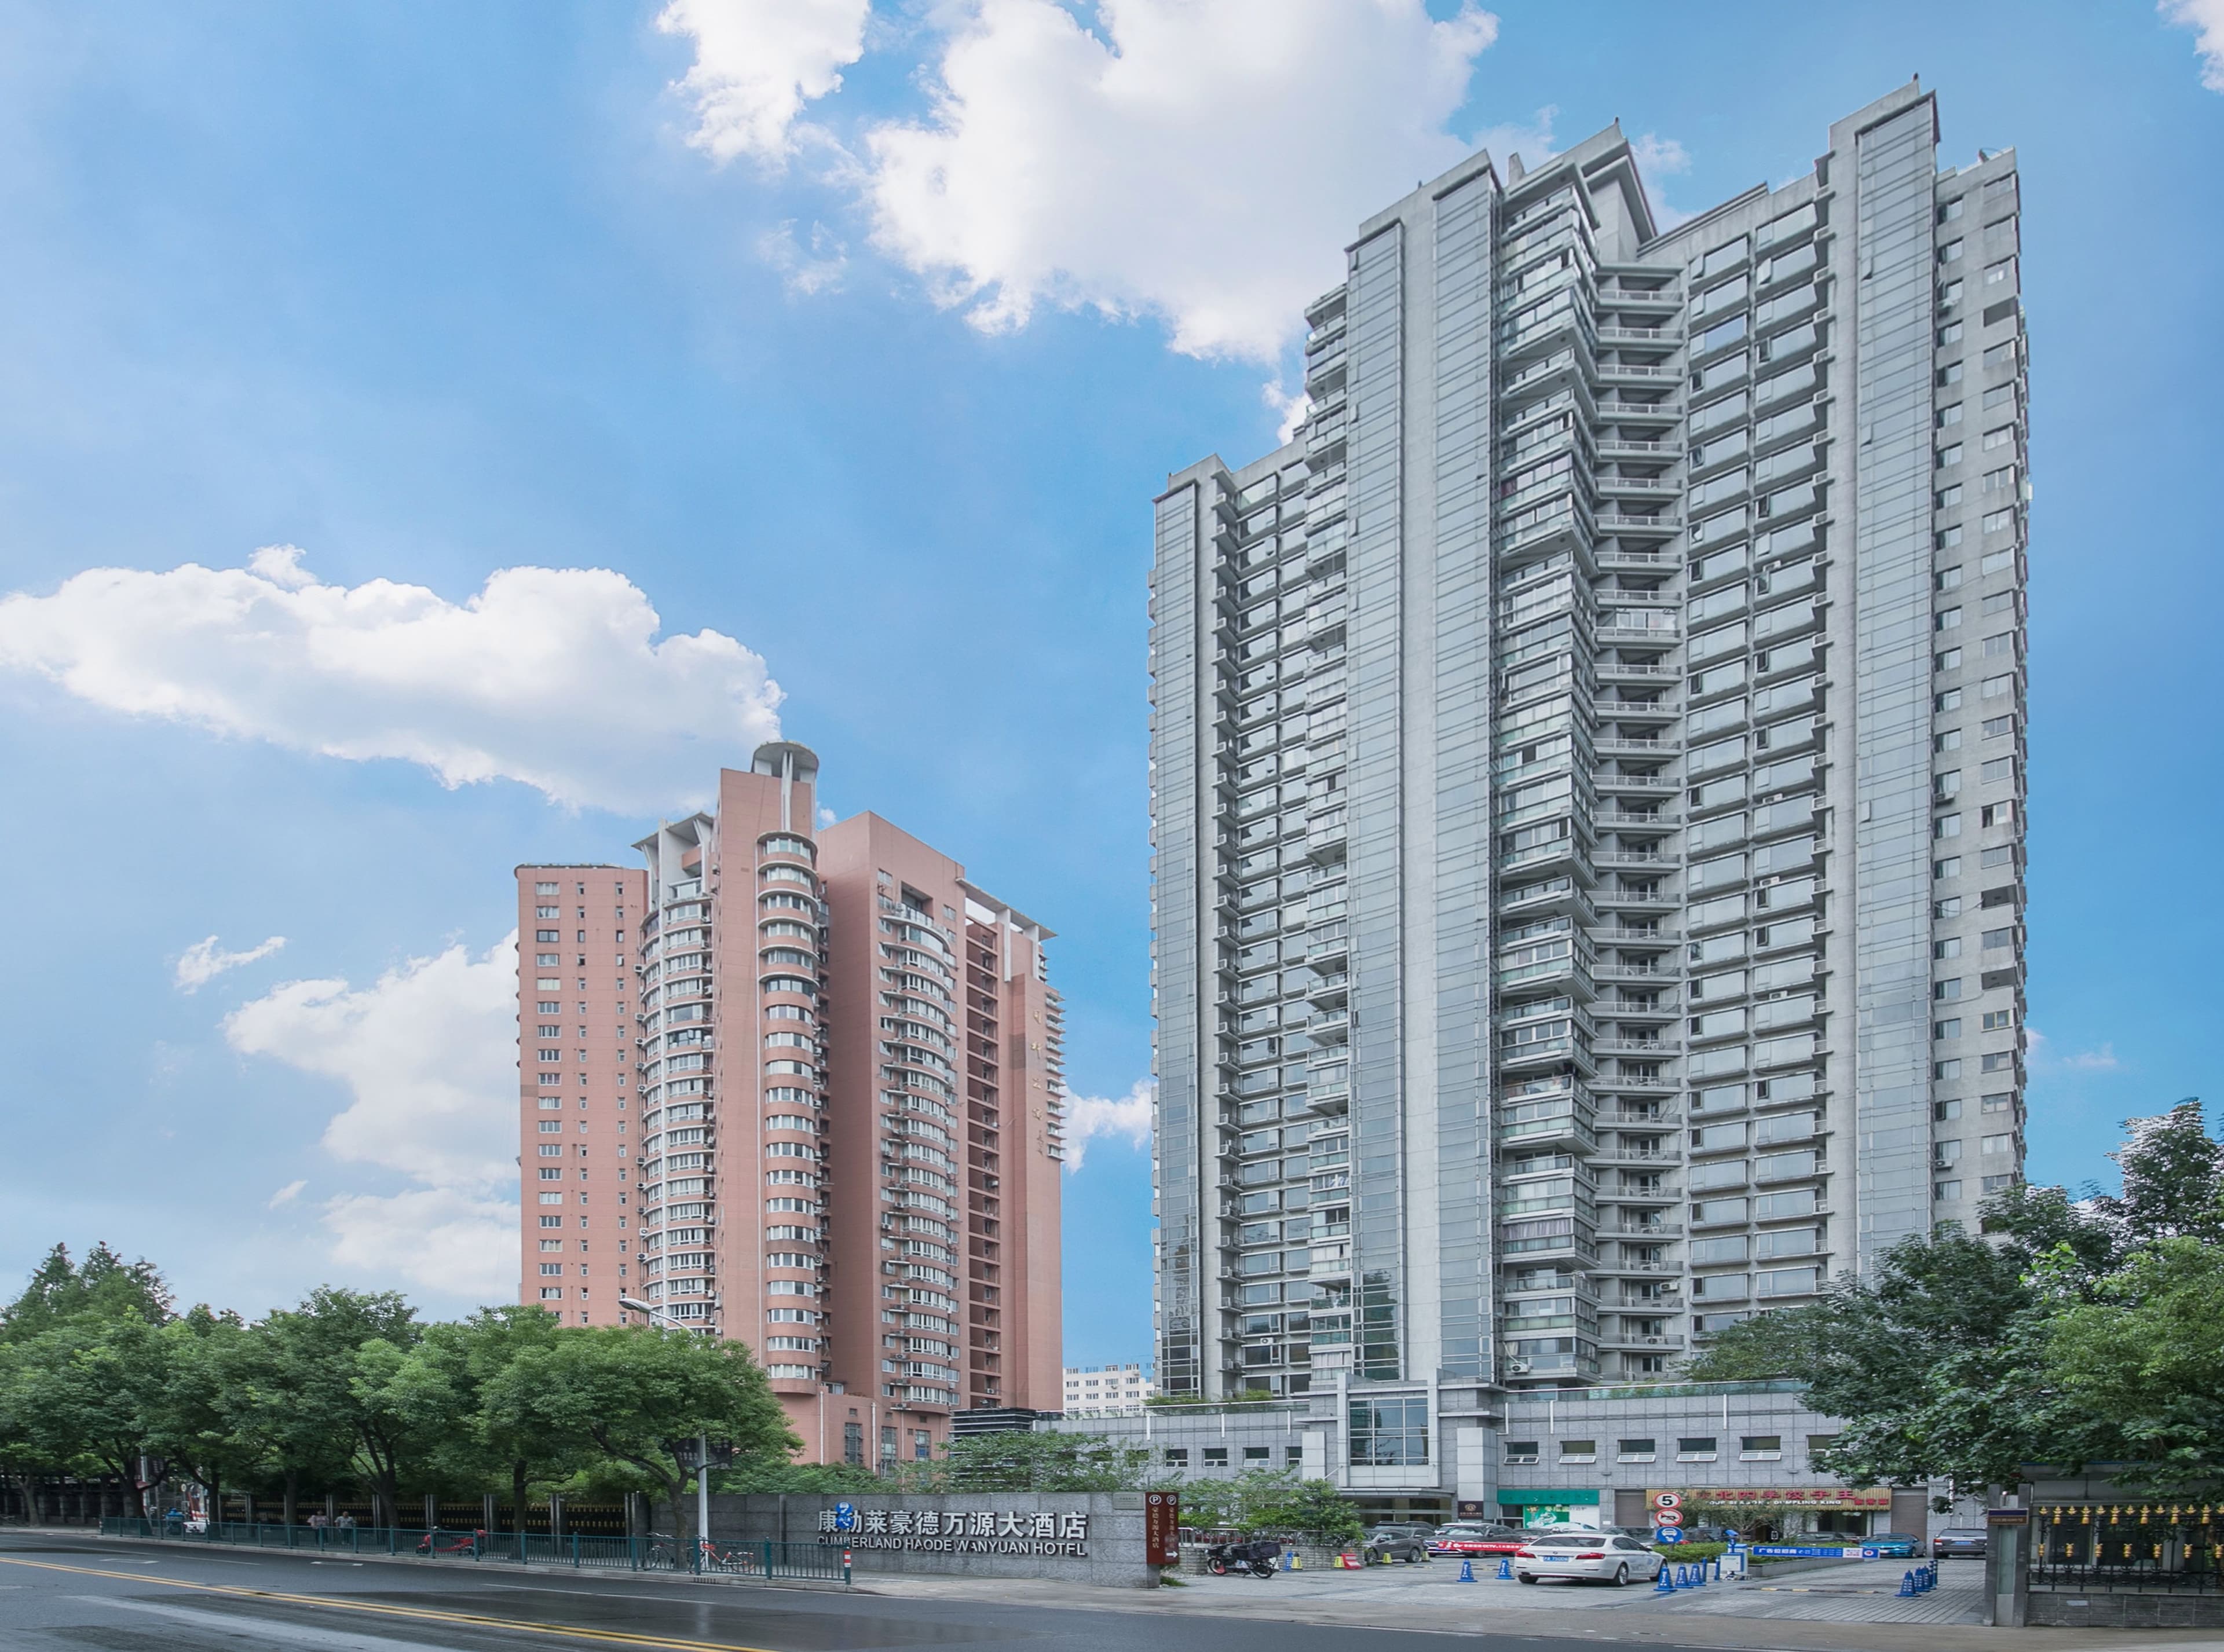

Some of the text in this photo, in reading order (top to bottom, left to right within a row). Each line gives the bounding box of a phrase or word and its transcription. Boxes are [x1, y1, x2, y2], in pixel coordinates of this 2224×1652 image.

[1662, 1495, 1673, 1506] 5
[905, 1539, 953, 1551] HAODE
[957, 1540, 1029, 1554] WANYUAN
